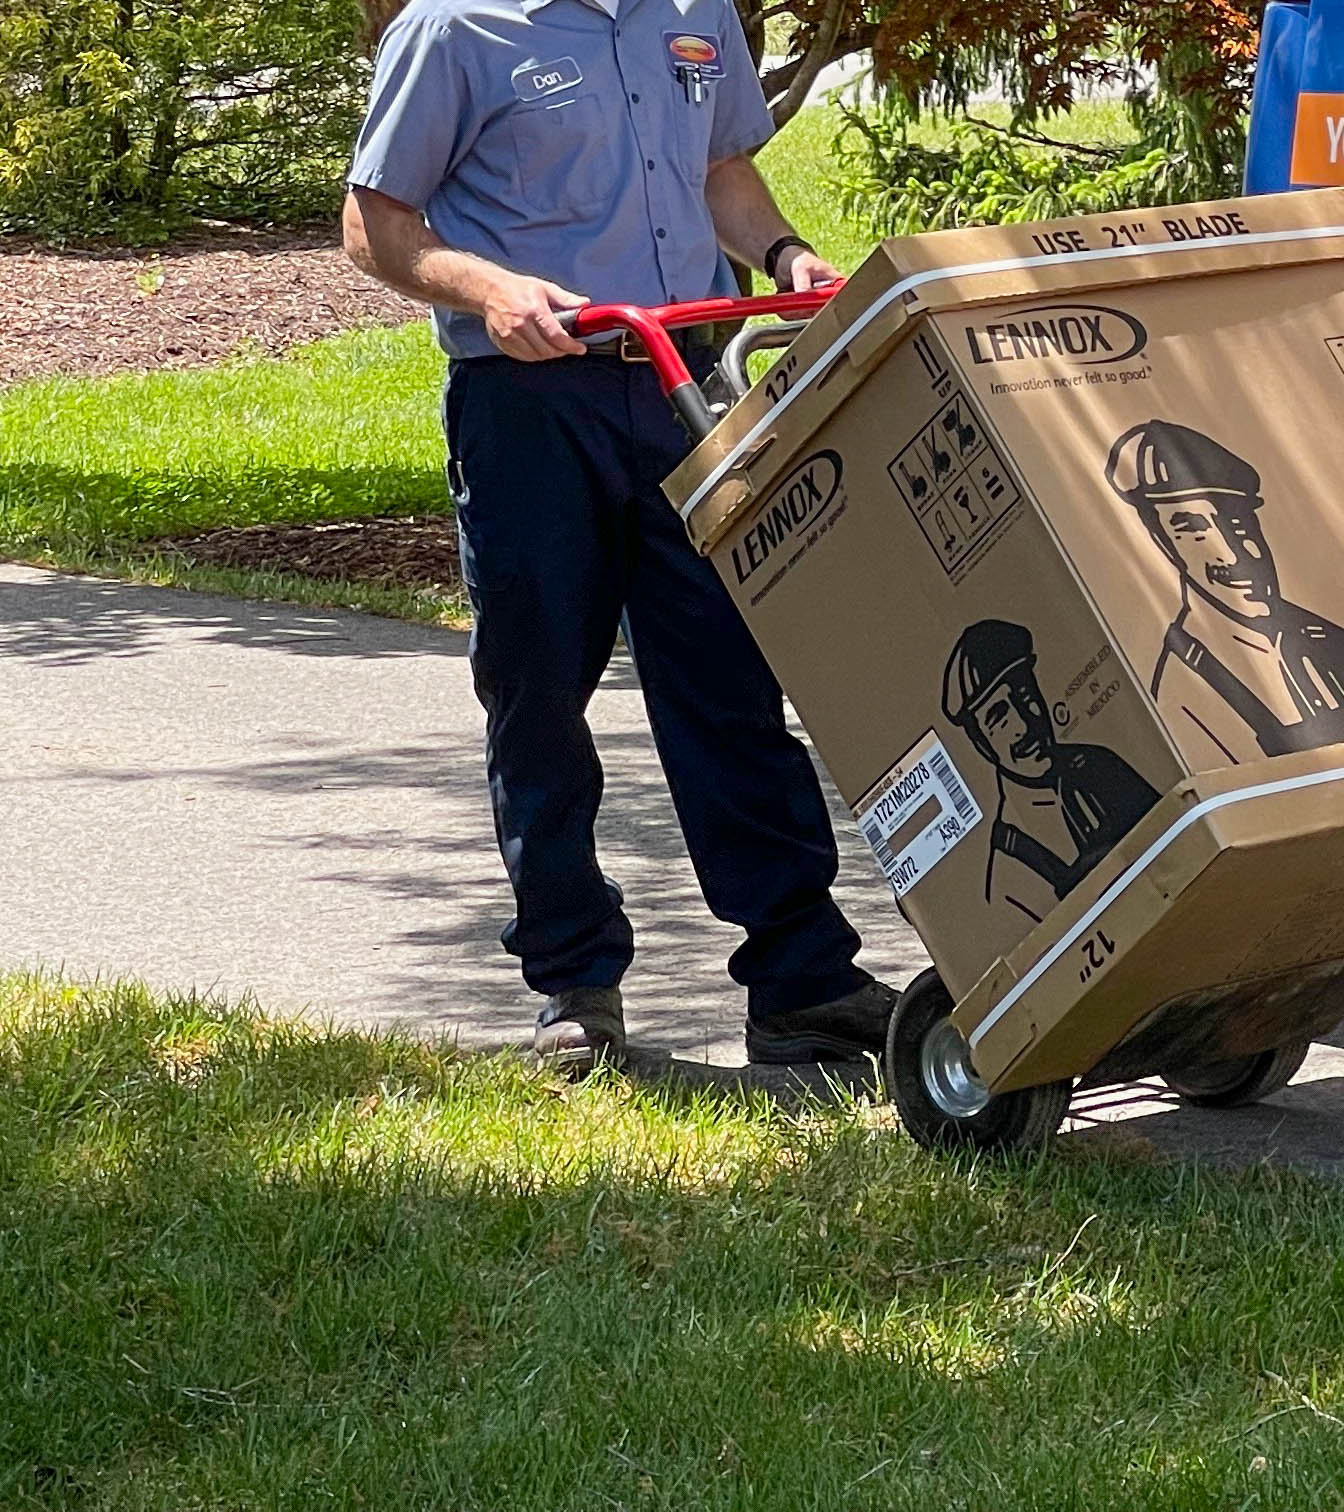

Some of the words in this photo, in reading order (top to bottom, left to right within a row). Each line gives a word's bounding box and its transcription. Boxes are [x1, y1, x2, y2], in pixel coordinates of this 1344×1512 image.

[533, 72, 563, 89] Dan
[1032, 230, 1090, 255] USE
[1101, 223, 1145, 248] 21"
[1161, 212, 1249, 242] BLADE
[965, 315, 1113, 364] LENNOX
[765, 355, 797, 404] 12"
[938, 379, 954, 399] UP
[990, 377, 1050, 395] Innovation
[1054, 377, 1083, 389] never
[1085, 370, 1103, 385] felt
[1105, 372, 1117, 383] so
[731, 465, 823, 585] LENNOX
[1065, 644, 1112, 701] ASSEMBLED
[1088, 680, 1101, 696] IN
[1086, 680, 1121, 719] MEXICO
[873, 762, 931, 826] 1721M20278
[1080, 930, 1115, 983] 12"
